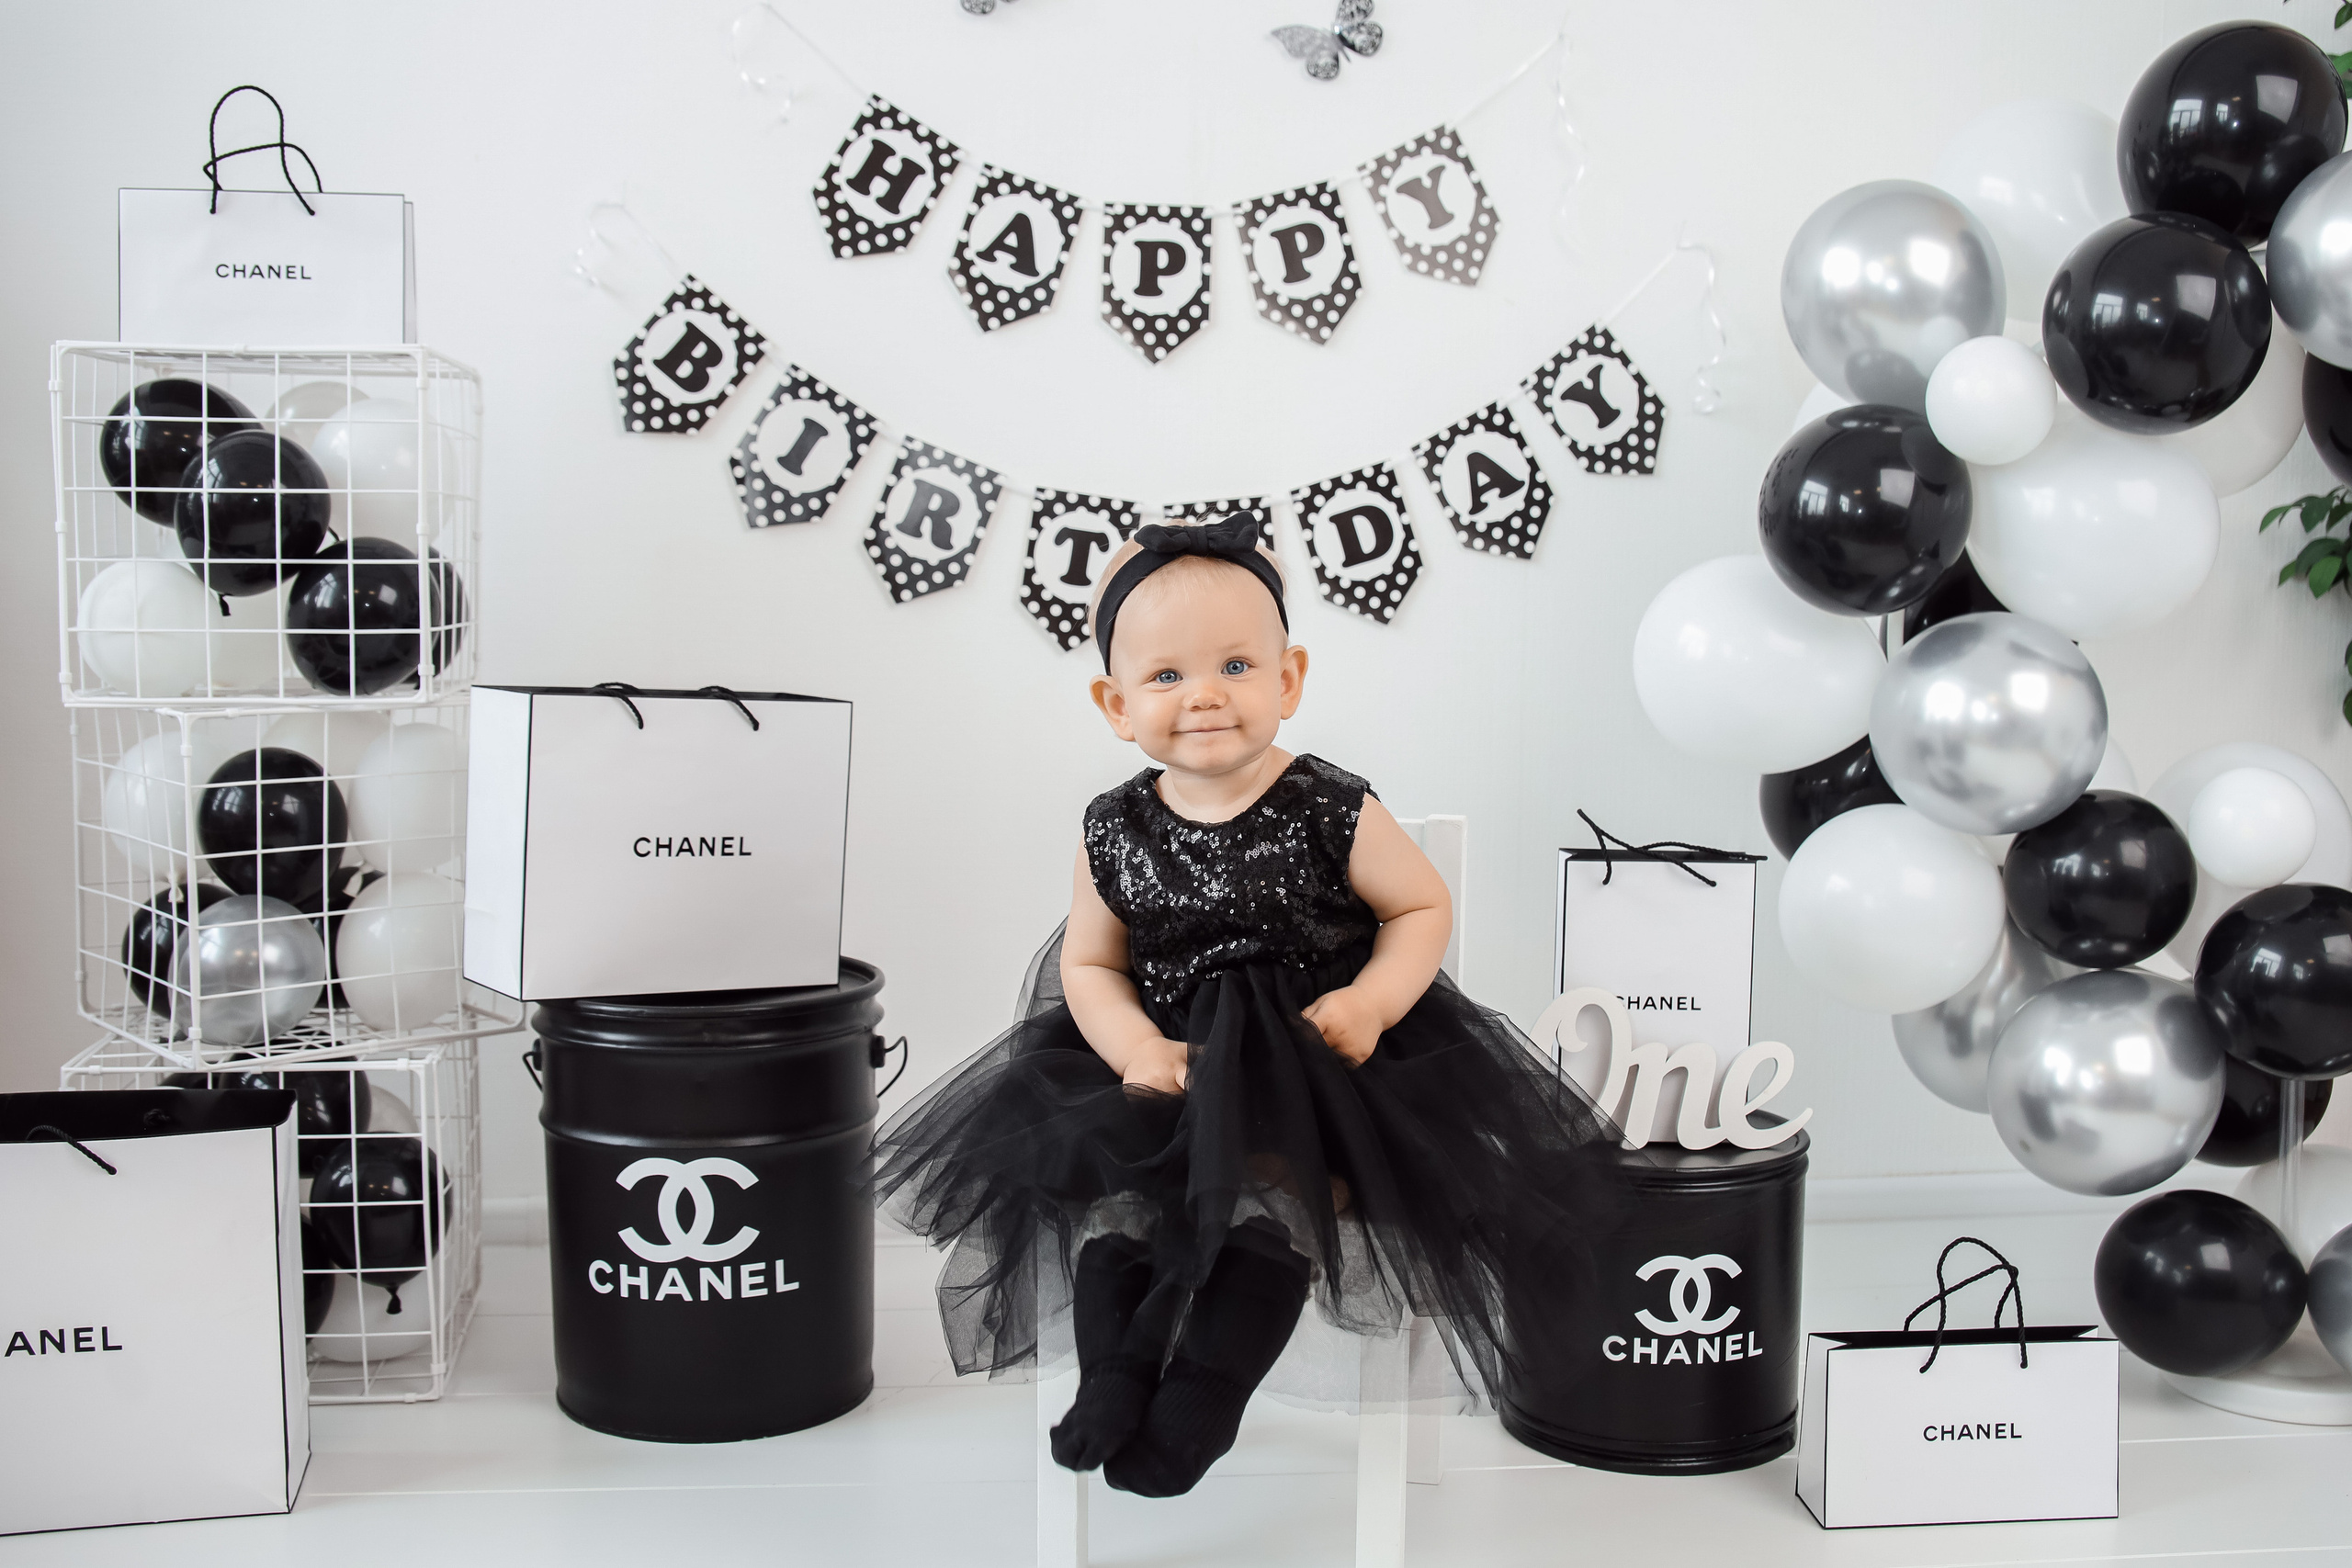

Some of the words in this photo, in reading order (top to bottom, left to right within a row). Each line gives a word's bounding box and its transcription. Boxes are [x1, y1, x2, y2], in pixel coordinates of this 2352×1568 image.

[845, 139, 1455, 298] HAPPY
[215, 264, 311, 280] CHANEL
[652, 321, 1622, 587] BIRTDAY
[633, 836, 752, 858] CHANEL
[1616, 995, 1702, 1011] HANEL
[1521, 986, 1814, 1151] One
[588, 1258, 800, 1302] CHANEL
[1602, 1330, 1763, 1365] CHANEL
[1923, 1422, 2022, 1442] CHANEL
